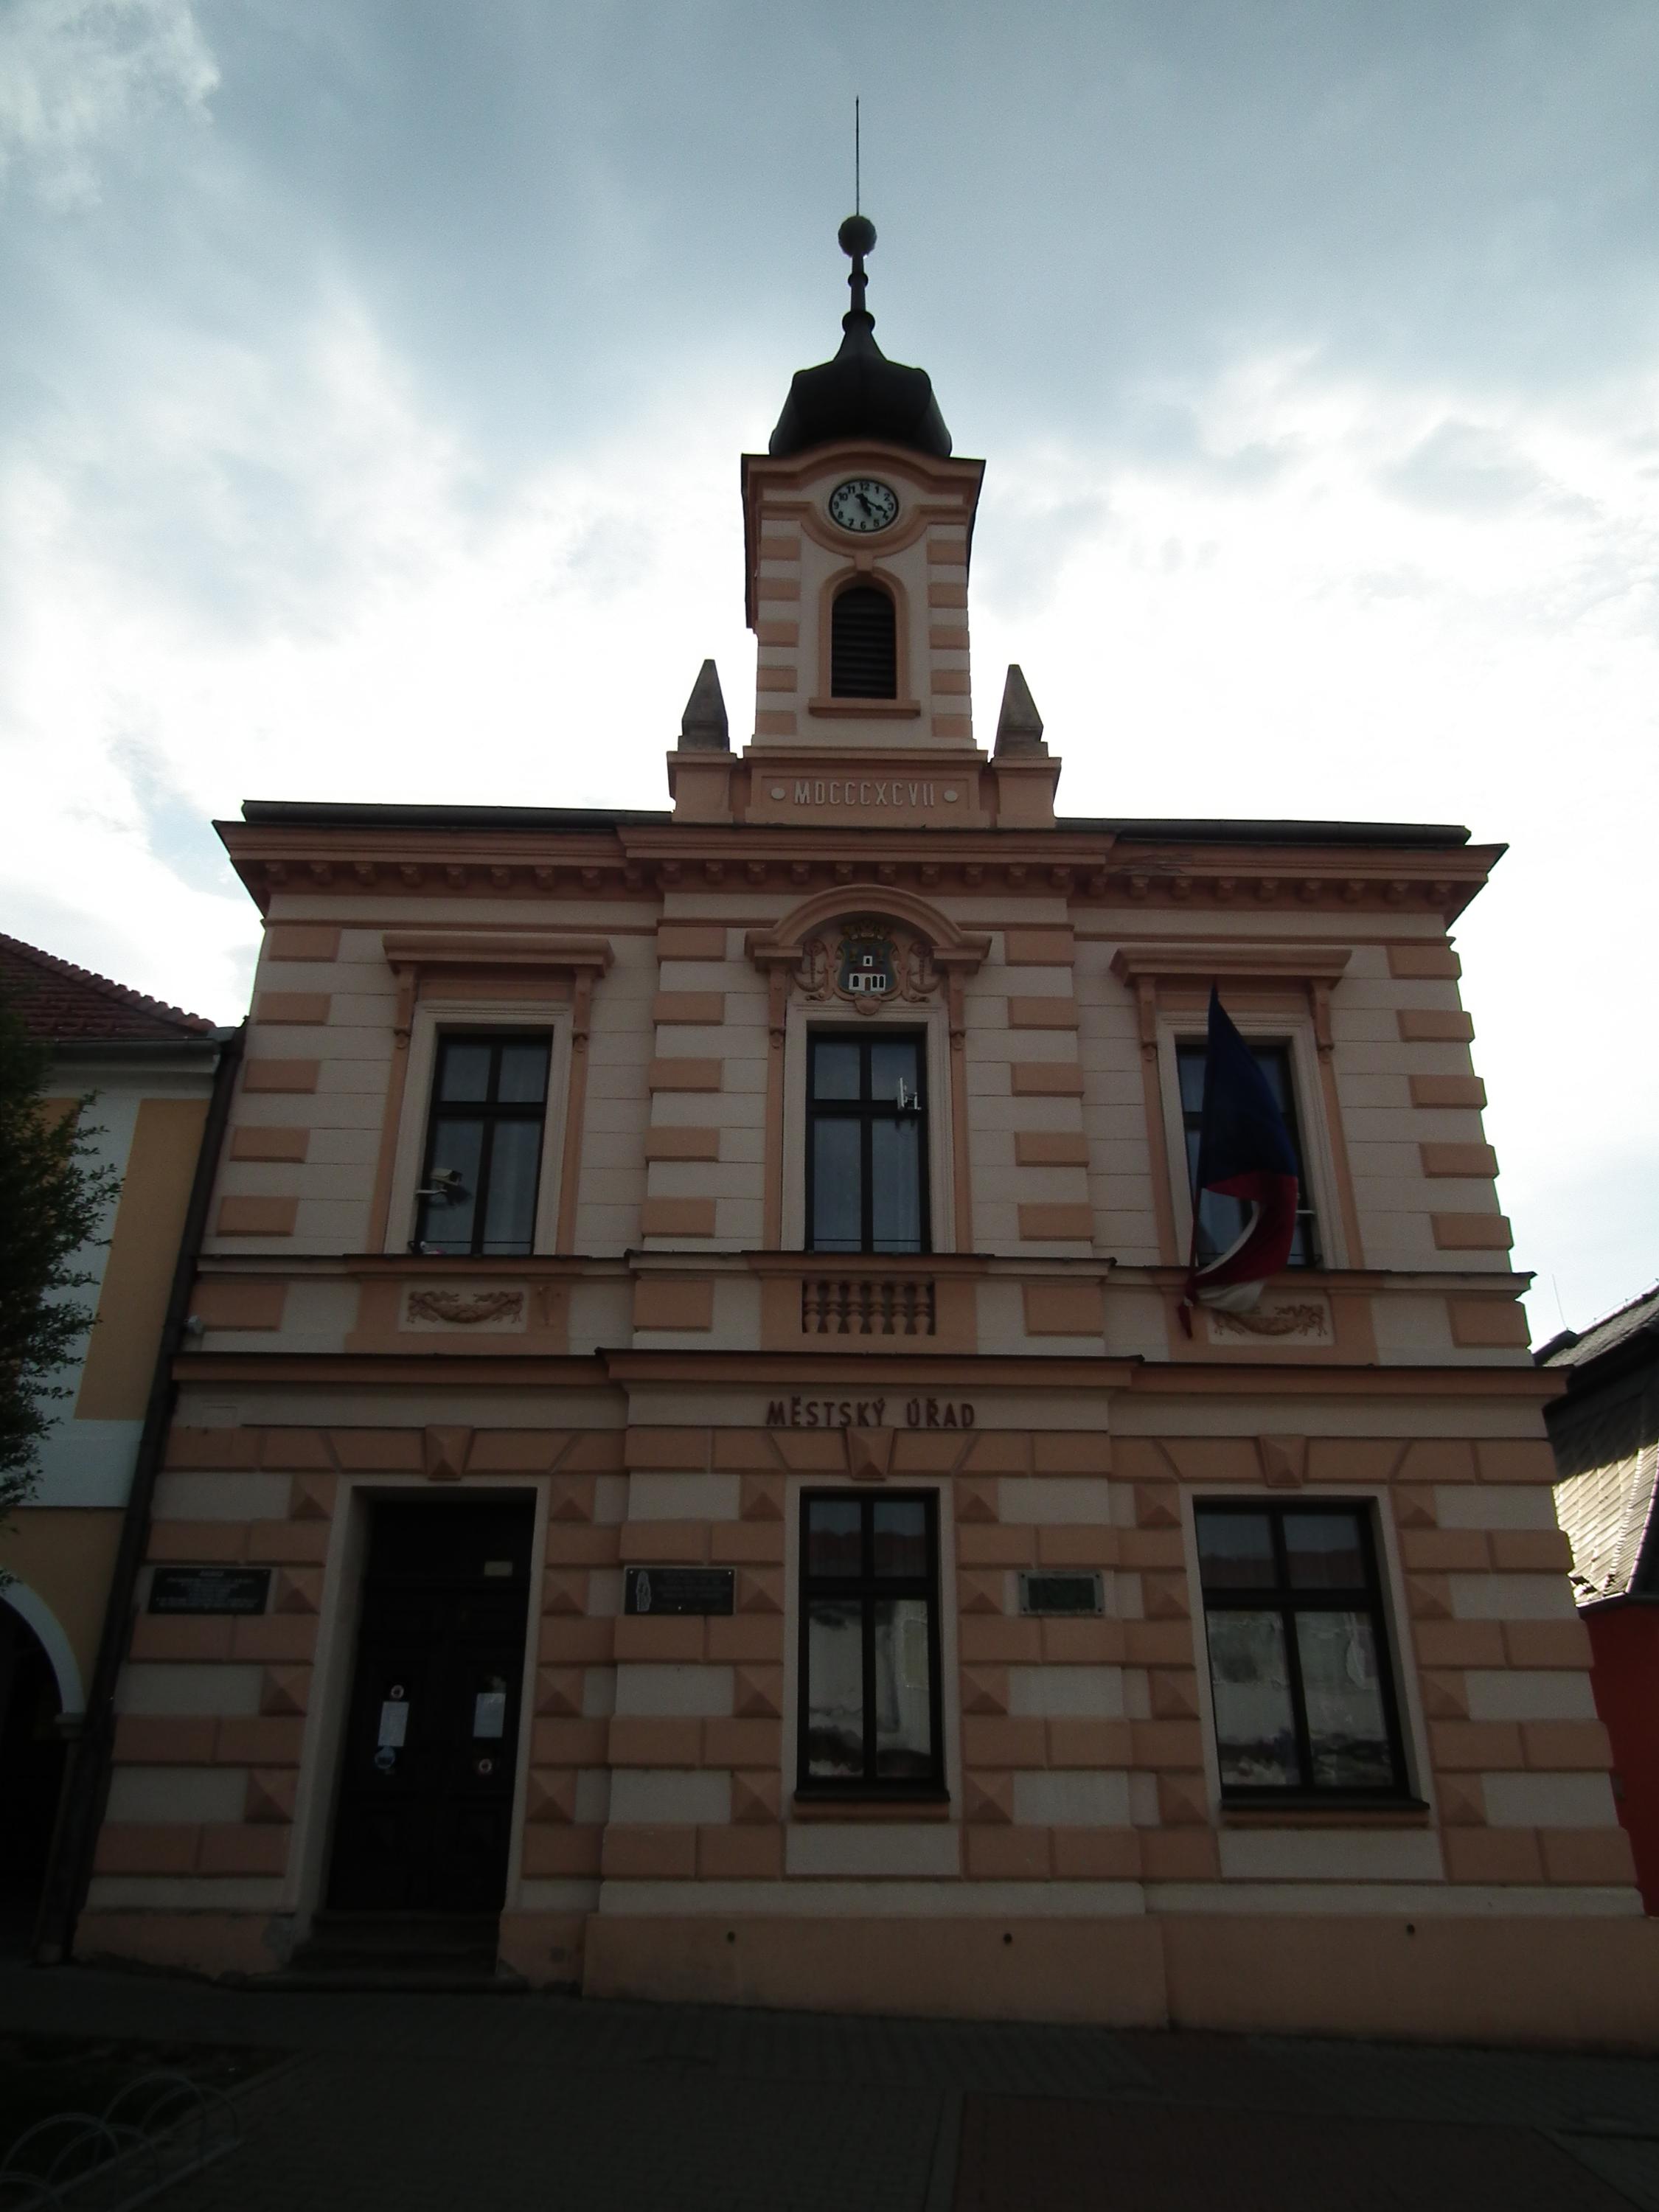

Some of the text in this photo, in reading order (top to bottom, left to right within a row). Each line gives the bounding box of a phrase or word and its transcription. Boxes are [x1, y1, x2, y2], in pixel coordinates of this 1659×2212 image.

[846, 485, 855, 493] 11
[859, 482, 870, 491] 12
[838, 493, 848, 501] 10
[884, 493, 890, 501] 2
[834, 501, 839, 509] 9
[888, 502, 894, 511] 3
[838, 511, 844, 519] 8
[848, 518, 854, 526] 7
[860, 521, 866, 529] 6
[874, 519, 880, 527] 5
[793, 781, 935, 807] MDCCCXCVII
[766, 1397, 975, 1428] MĚSTSKÝ ÚŘAD
